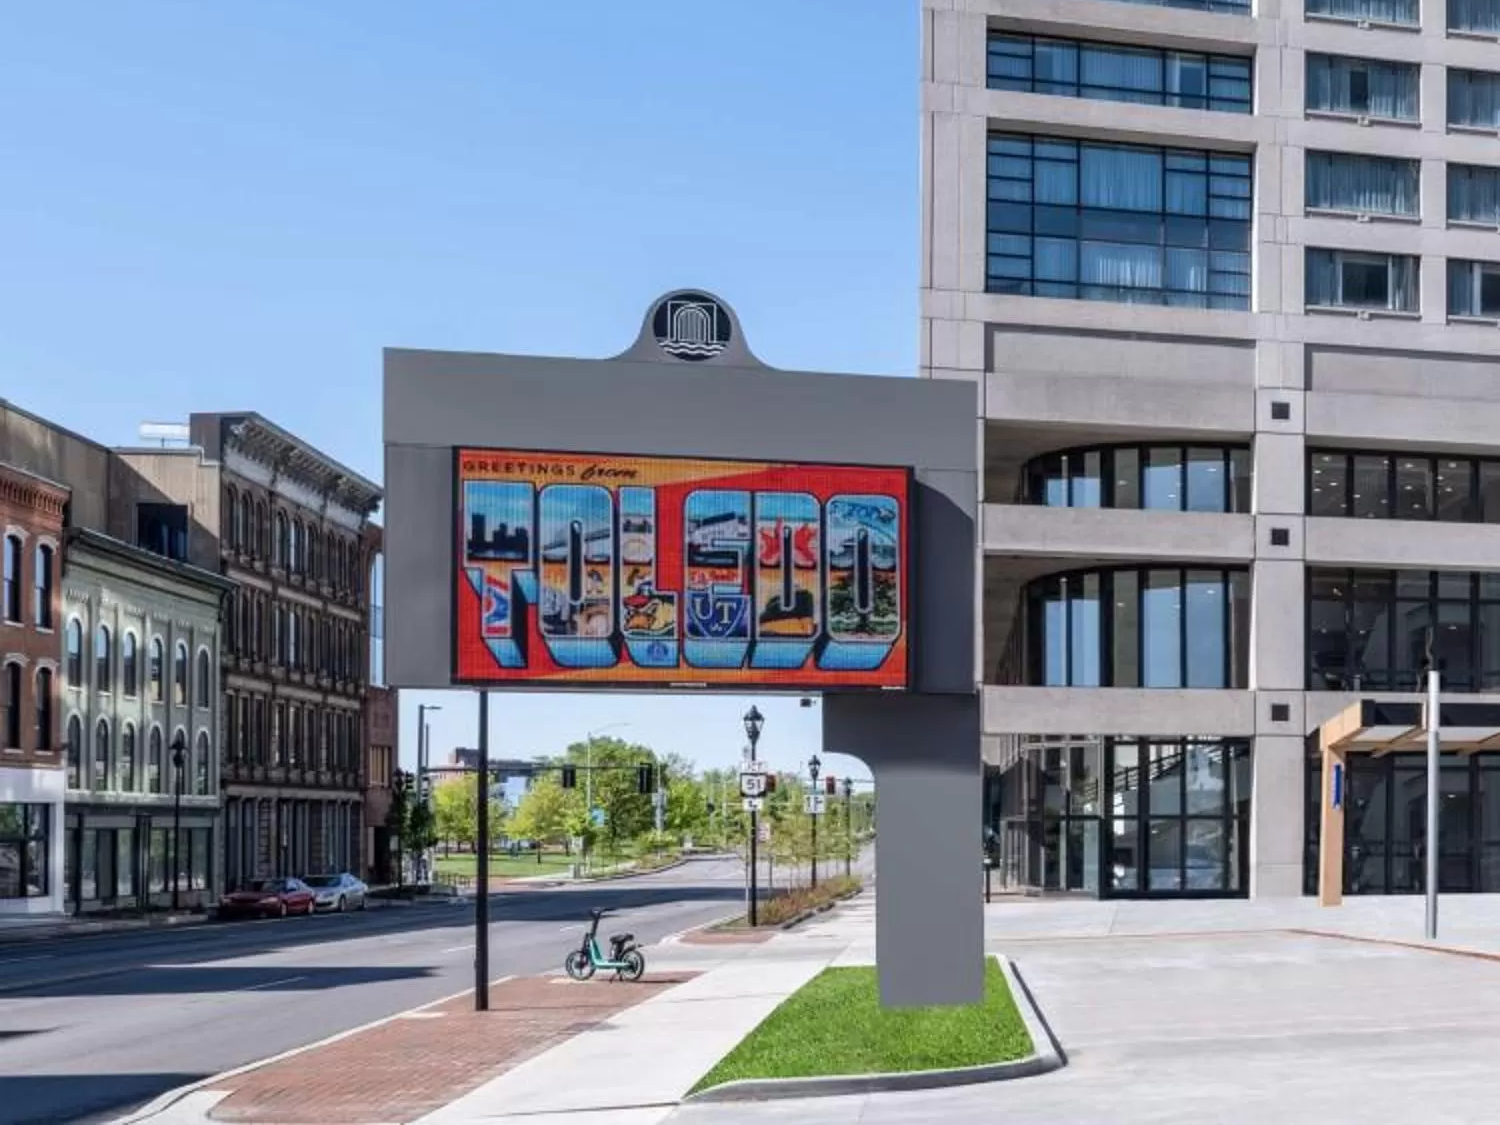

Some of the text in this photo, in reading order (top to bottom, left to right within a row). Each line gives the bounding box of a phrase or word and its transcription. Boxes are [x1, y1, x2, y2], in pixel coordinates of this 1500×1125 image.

[463, 461, 638, 481] GREETINGS from
[463, 479, 901, 668] TOLEDO
[746, 778, 762, 791] 51
